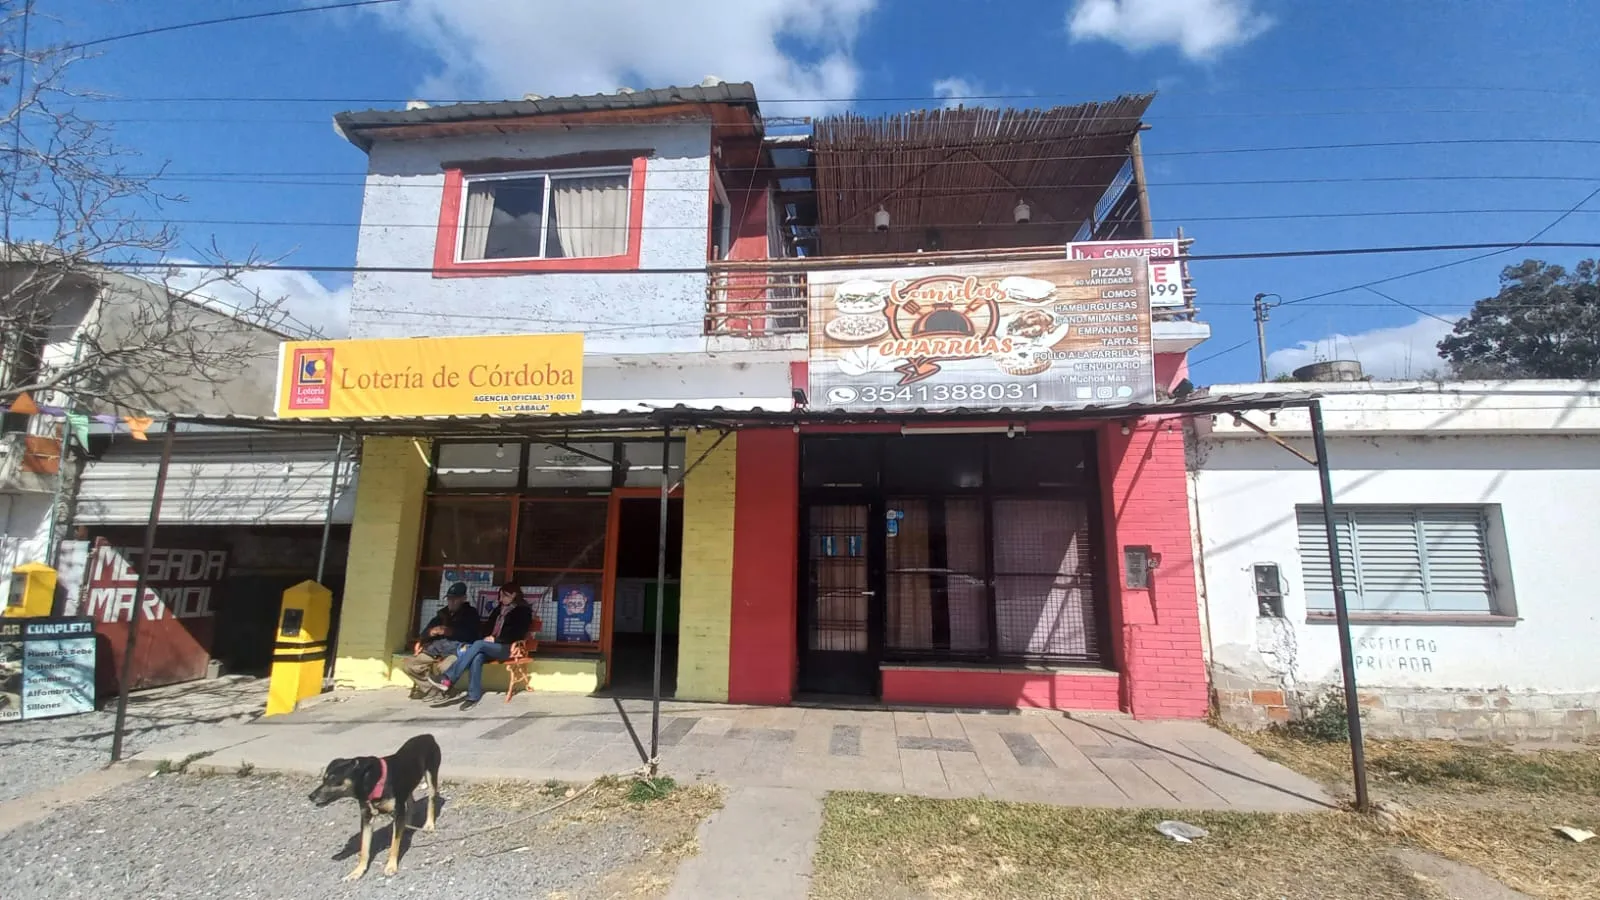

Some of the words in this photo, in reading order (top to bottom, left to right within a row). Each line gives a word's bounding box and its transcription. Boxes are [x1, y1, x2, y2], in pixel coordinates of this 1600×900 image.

[1104, 247, 1171, 257] CANAVESIO
[1090, 267, 1132, 278] PIZZAS
[1085, 277, 1133, 286] VARIEDADES
[890, 277, 1007, 302] Comidas
[1102, 289, 1137, 298] LOMOS
[1054, 301, 1138, 312] HAMBURGUESAS
[1087, 313, 1138, 323] MILANESA
[1078, 325, 1138, 335] EMPANADAS
[1102, 337, 1139, 346] TARTAS
[1034, 351, 1066, 360] POLLO
[1068, 351, 1075, 359] A
[1077, 351, 1090, 359] LA
[1092, 349, 1140, 358] PARRILLA
[1105, 361, 1140, 370] DIARIO
[340, 366, 424, 390] Lotería
[432, 365, 460, 388] de
[468, 362, 574, 388] Córdoba
[1061, 375, 1067, 384] Y
[1069, 375, 1105, 383] Muchos
[861, 383, 1039, 402] 3541388031
[94, 545, 228, 581] MESADA
[87, 586, 216, 623] MARMOL
[27, 622, 92, 635] COMPLETA
[28, 649, 68, 658] Huevitos
[27, 702, 62, 711] Sillones
